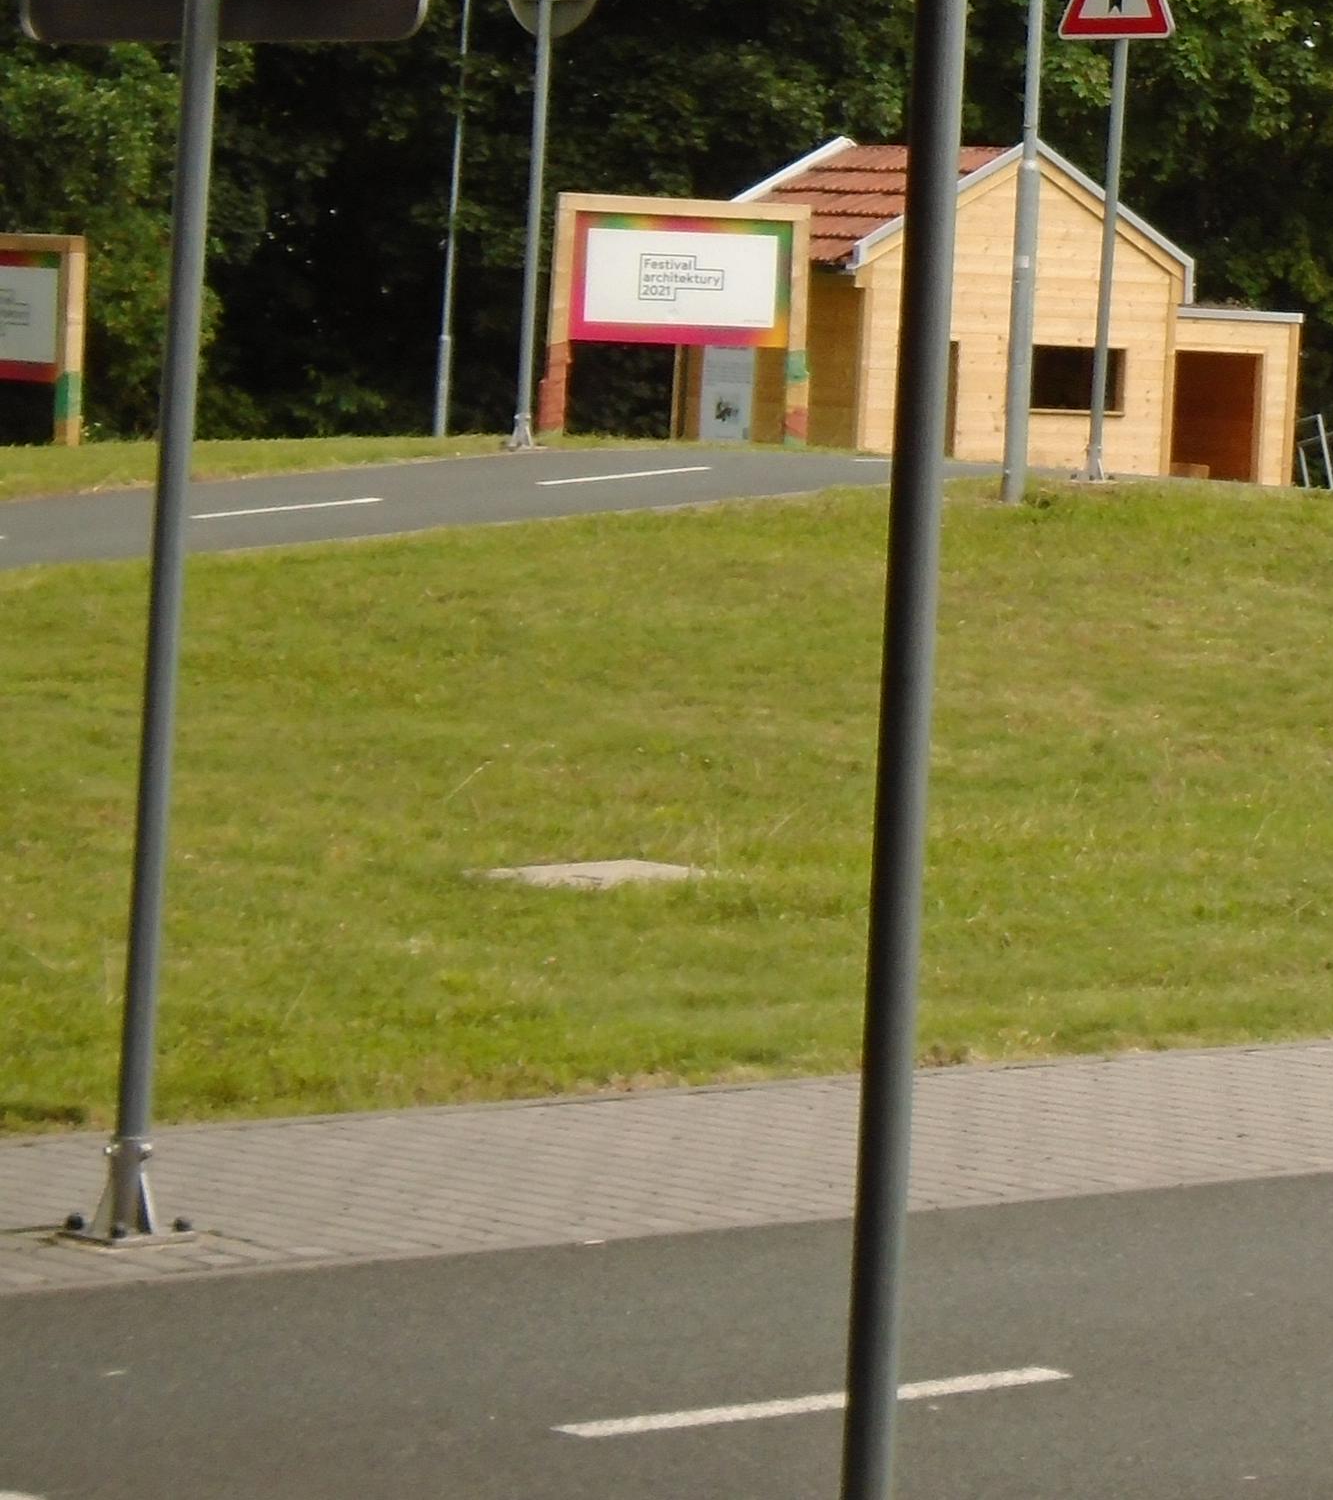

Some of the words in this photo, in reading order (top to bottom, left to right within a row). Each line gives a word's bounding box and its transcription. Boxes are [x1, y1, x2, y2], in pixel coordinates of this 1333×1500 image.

[643, 258, 694, 271] Festival
[642, 271, 721, 286] architektury
[642, 285, 671, 297] 2021
